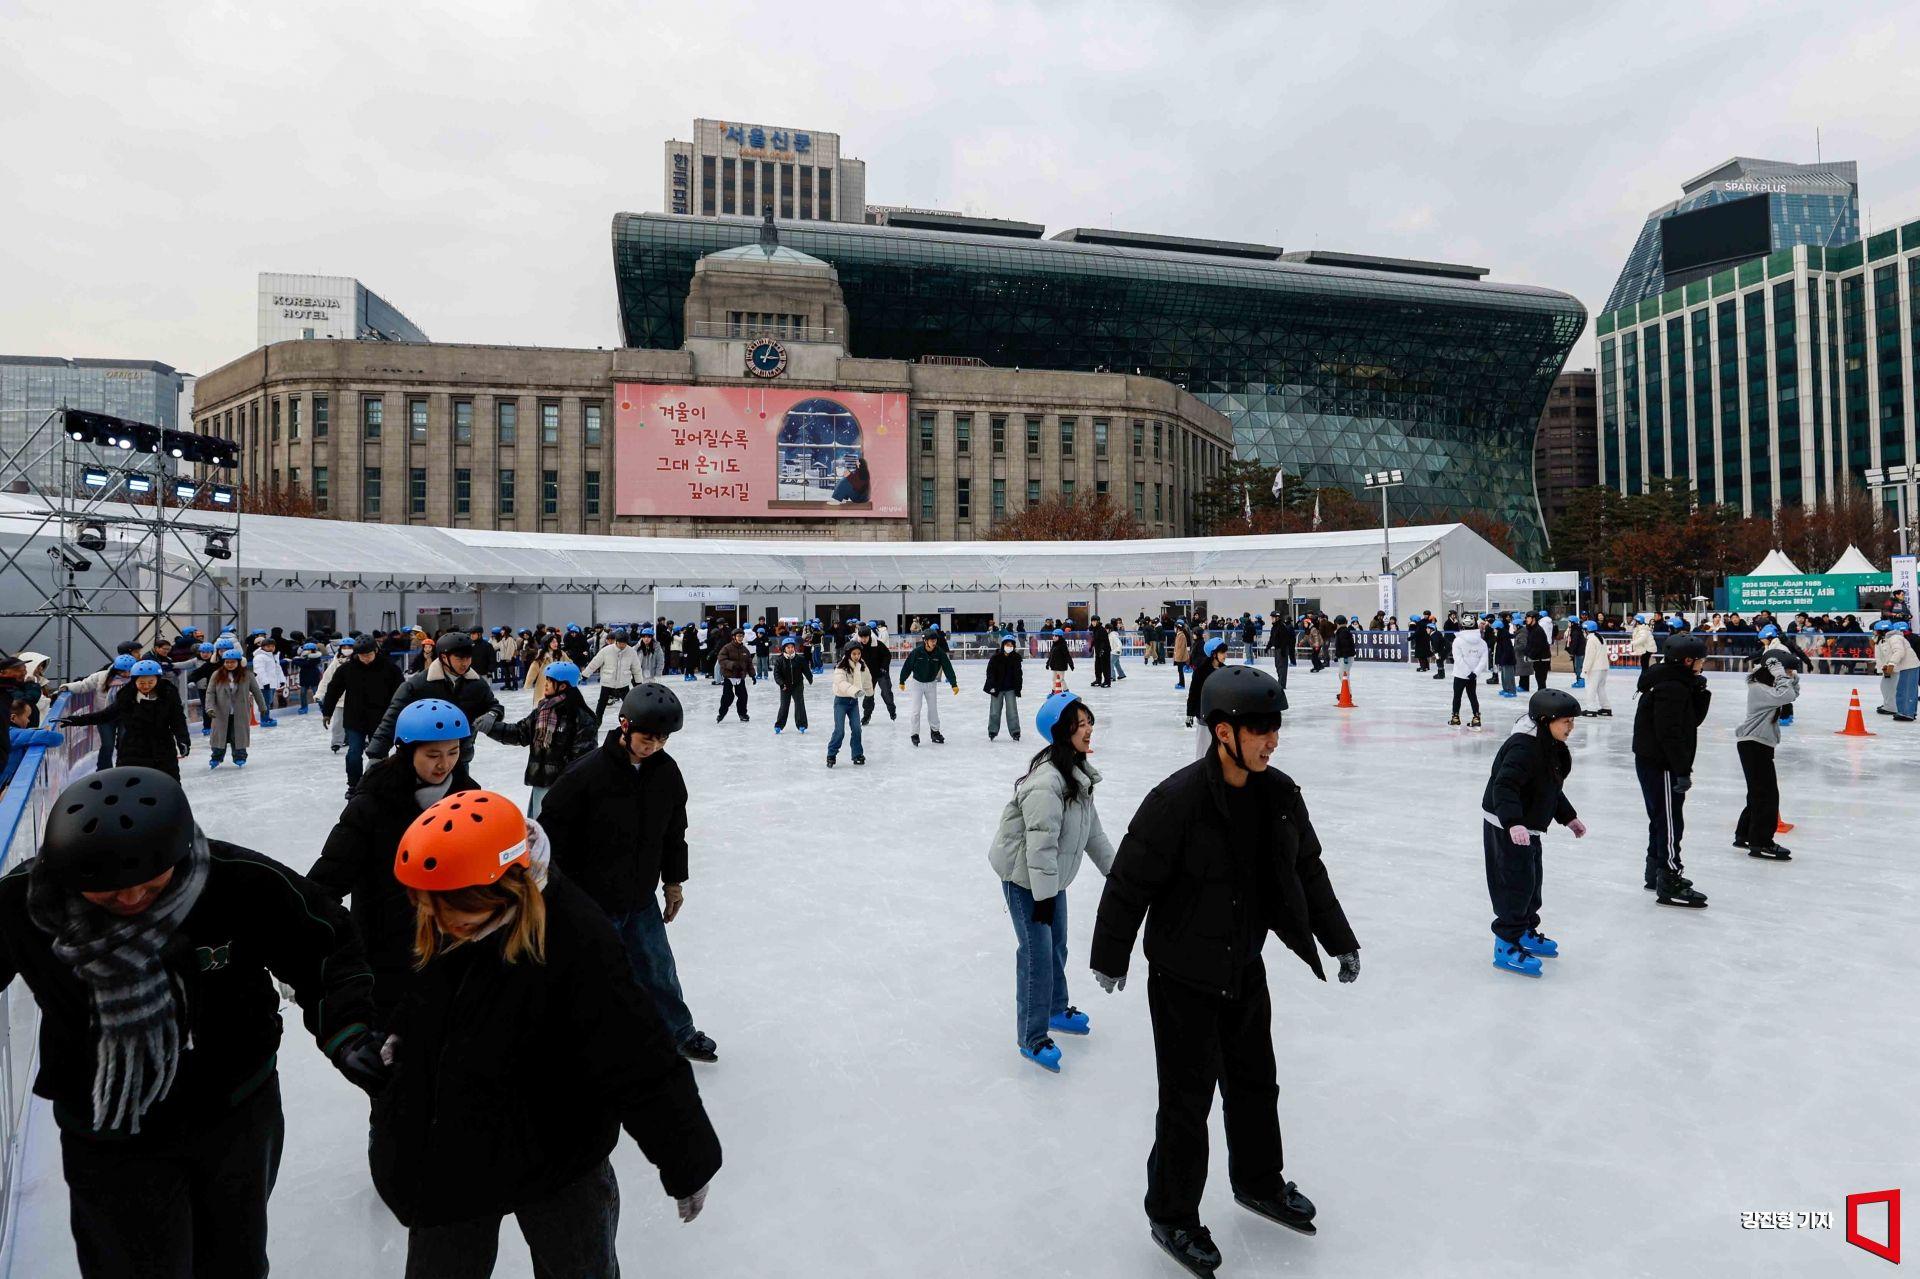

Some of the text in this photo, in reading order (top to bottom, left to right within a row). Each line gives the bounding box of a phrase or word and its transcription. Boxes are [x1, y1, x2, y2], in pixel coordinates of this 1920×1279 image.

[725, 126, 812, 153] 서울신문
[272, 295, 340, 309] KOREANA
[282, 308, 329, 321] HOTEL
[659, 401, 706, 422] 겨울이
[671, 428, 749, 450] 깊어질수록
[656, 455, 741, 475] 그대 온기도
[687, 482, 749, 501] 깊어지길
[1768, 598, 1792, 606] Sports
[1372, 633, 1401, 645] SEOUL
[1378, 648, 1402, 660] 1988
